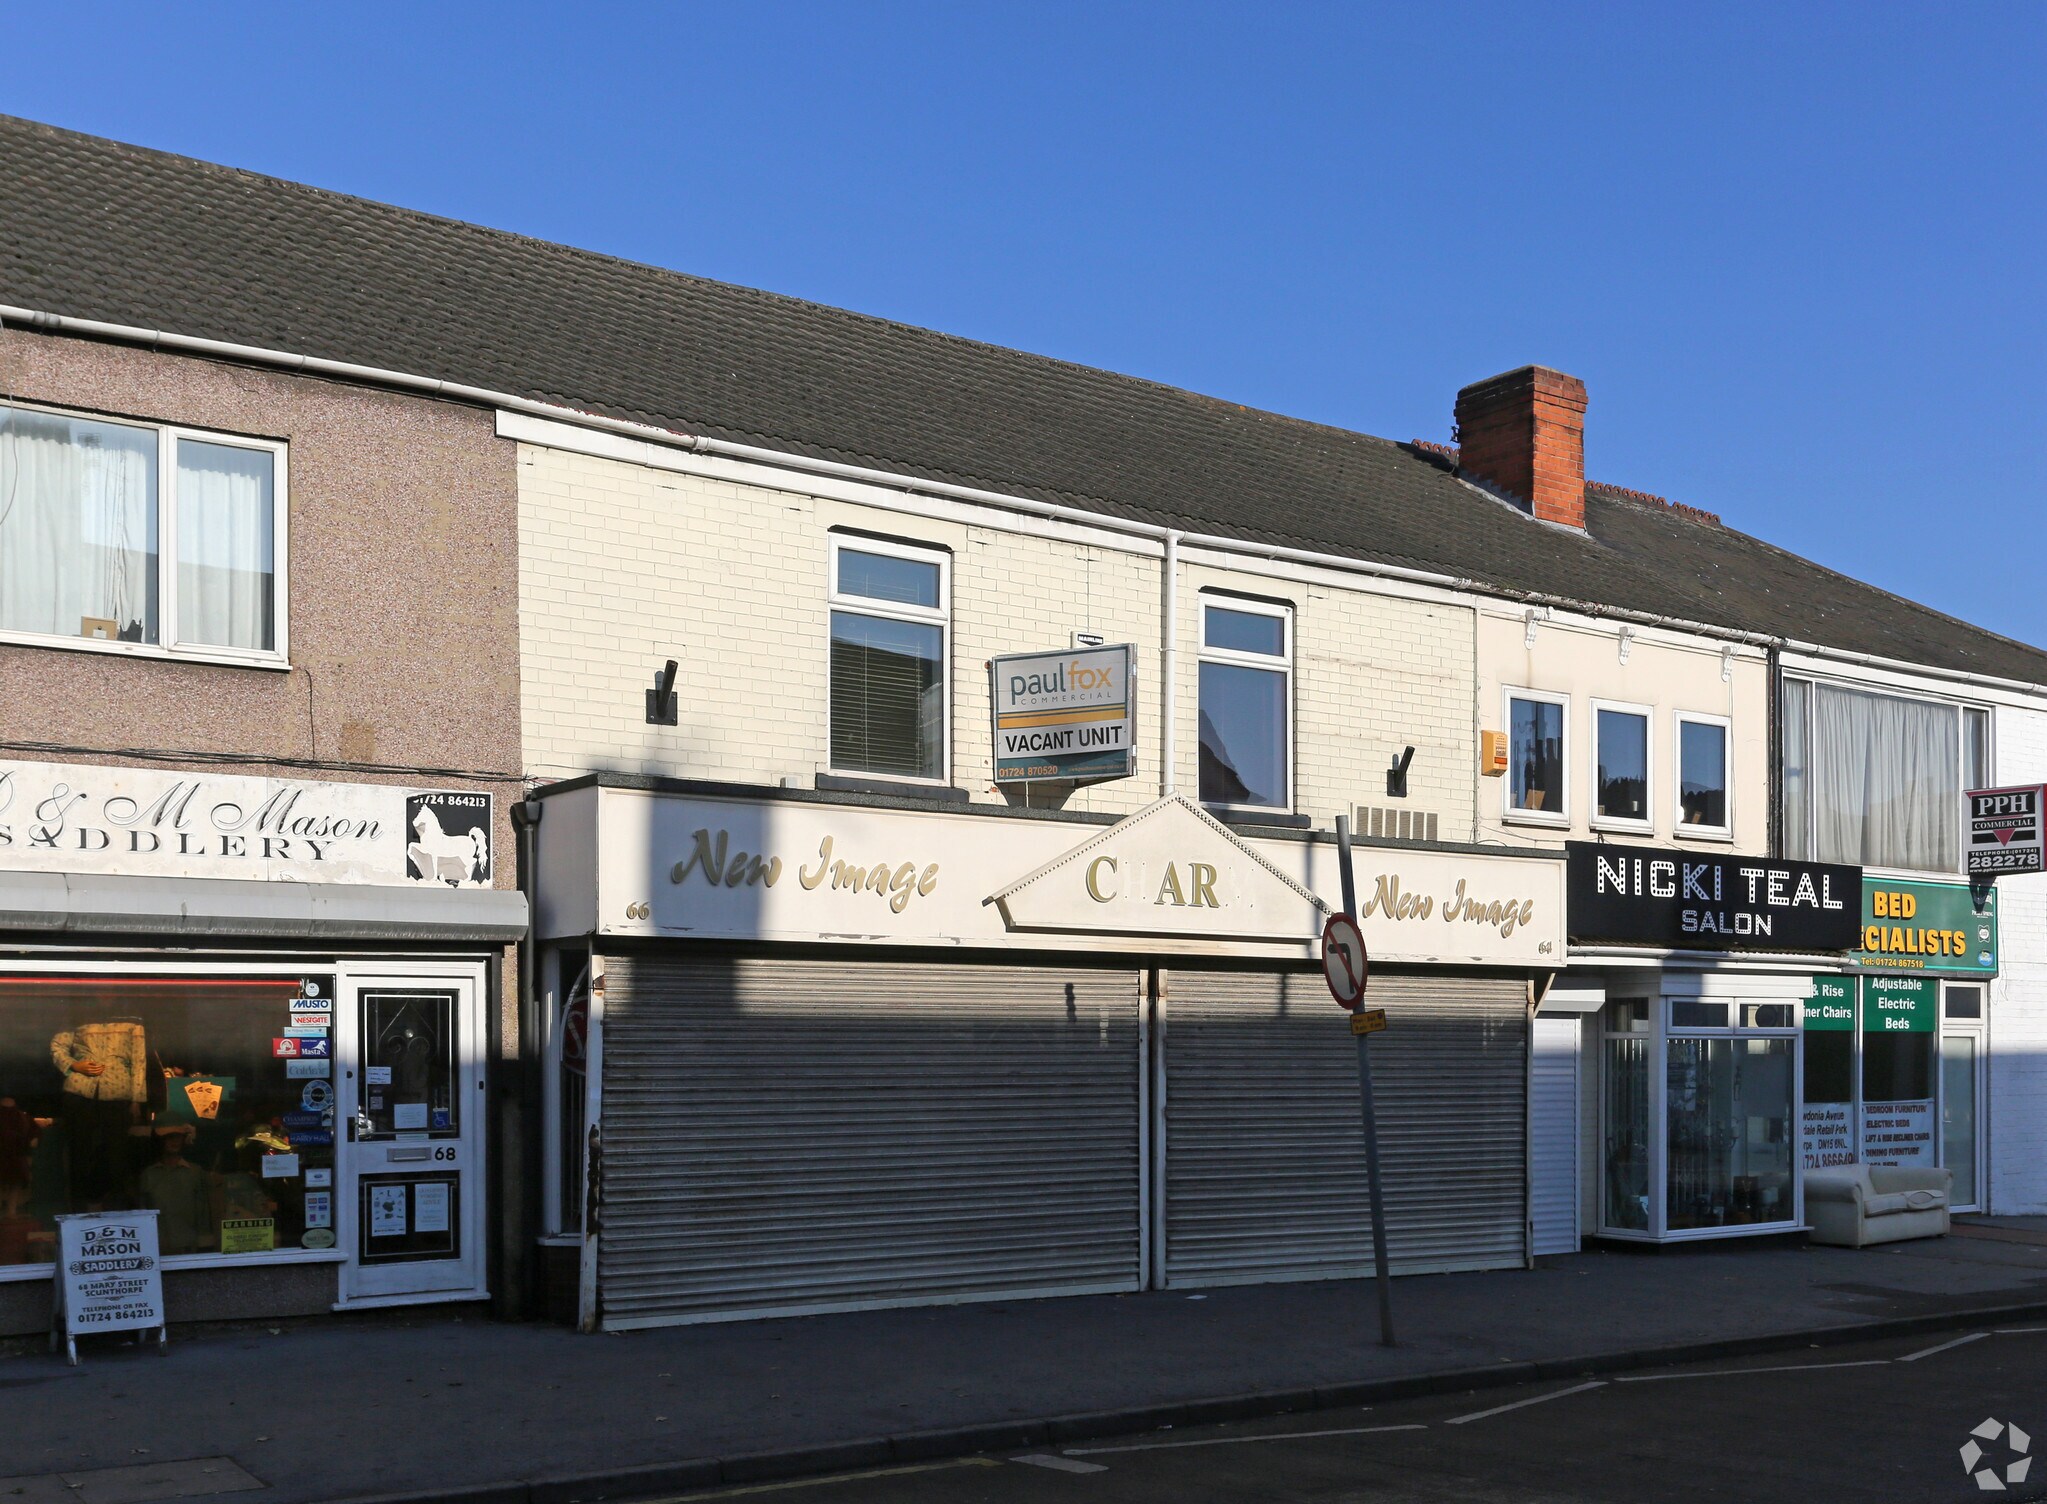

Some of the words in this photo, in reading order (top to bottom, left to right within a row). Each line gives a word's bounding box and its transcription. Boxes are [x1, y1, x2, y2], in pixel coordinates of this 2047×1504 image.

[1020, 692, 1112, 706] COMMERCIAL
[1005, 730, 1074, 752] VACANT
[1078, 725, 1123, 747] UNIT
[999, 767, 1025, 777] 01724
[1028, 765, 1058, 776] 870520
[448, 796, 486, 807] 864213
[1978, 794, 2029, 816] PPH
[29, 783, 87, 842] &
[104, 781, 201, 828] M
[211, 788, 384, 840] Mason
[1974, 819, 2033, 830] COMMERCIAL
[1969, 853, 2039, 869] 282278
[671, 828, 782, 887] New
[799, 835, 939, 914] Image
[1597, 855, 1722, 901] NICKI
[1740, 867, 1843, 910] TEAL
[1362, 873, 1434, 921] New
[1442, 878, 1534, 939] Image
[1873, 891, 1917, 920] BED
[1681, 909, 1772, 936] SALON
[1862, 925, 1967, 957] CIALISTS
[1861, 957, 1874, 966] Tel:
[1875, 957, 1897, 967] 01724
[1898, 959, 1924, 968] 867518
[1822, 984, 1844, 997] Rise
[1871, 977, 1923, 992] Adjustable
[293, 999, 329, 1009] MUSTO
[1877, 997, 1916, 1010] Electric
[1823, 1005, 1852, 1018] Chairs
[294, 1016, 328, 1024] WESTGATE
[1885, 1017, 1910, 1029] Beds
[1816, 1123, 1836, 1135] Retail
[1866, 1119, 1895, 1129] ELECTRIC
[434, 1148, 456, 1161] 68
[224, 1219, 272, 1228] WARNING
[85, 1231, 96, 1241] D
[102, 1227, 116, 1237] &
[121, 1228, 136, 1238] M
[82, 1242, 141, 1257] MASON
[84, 1259, 139, 1272] SADDLERY
[78, 1283, 89, 1291] 68
[91, 1281, 116, 1290] MARY
[118, 1279, 149, 1288] STREET
[85, 1286, 143, 1297] SCUNTHORPE
[81, 1304, 121, 1313] TELEPHONE
[78, 1312, 112, 1323] 01724
[115, 1308, 154, 1320] 864213
